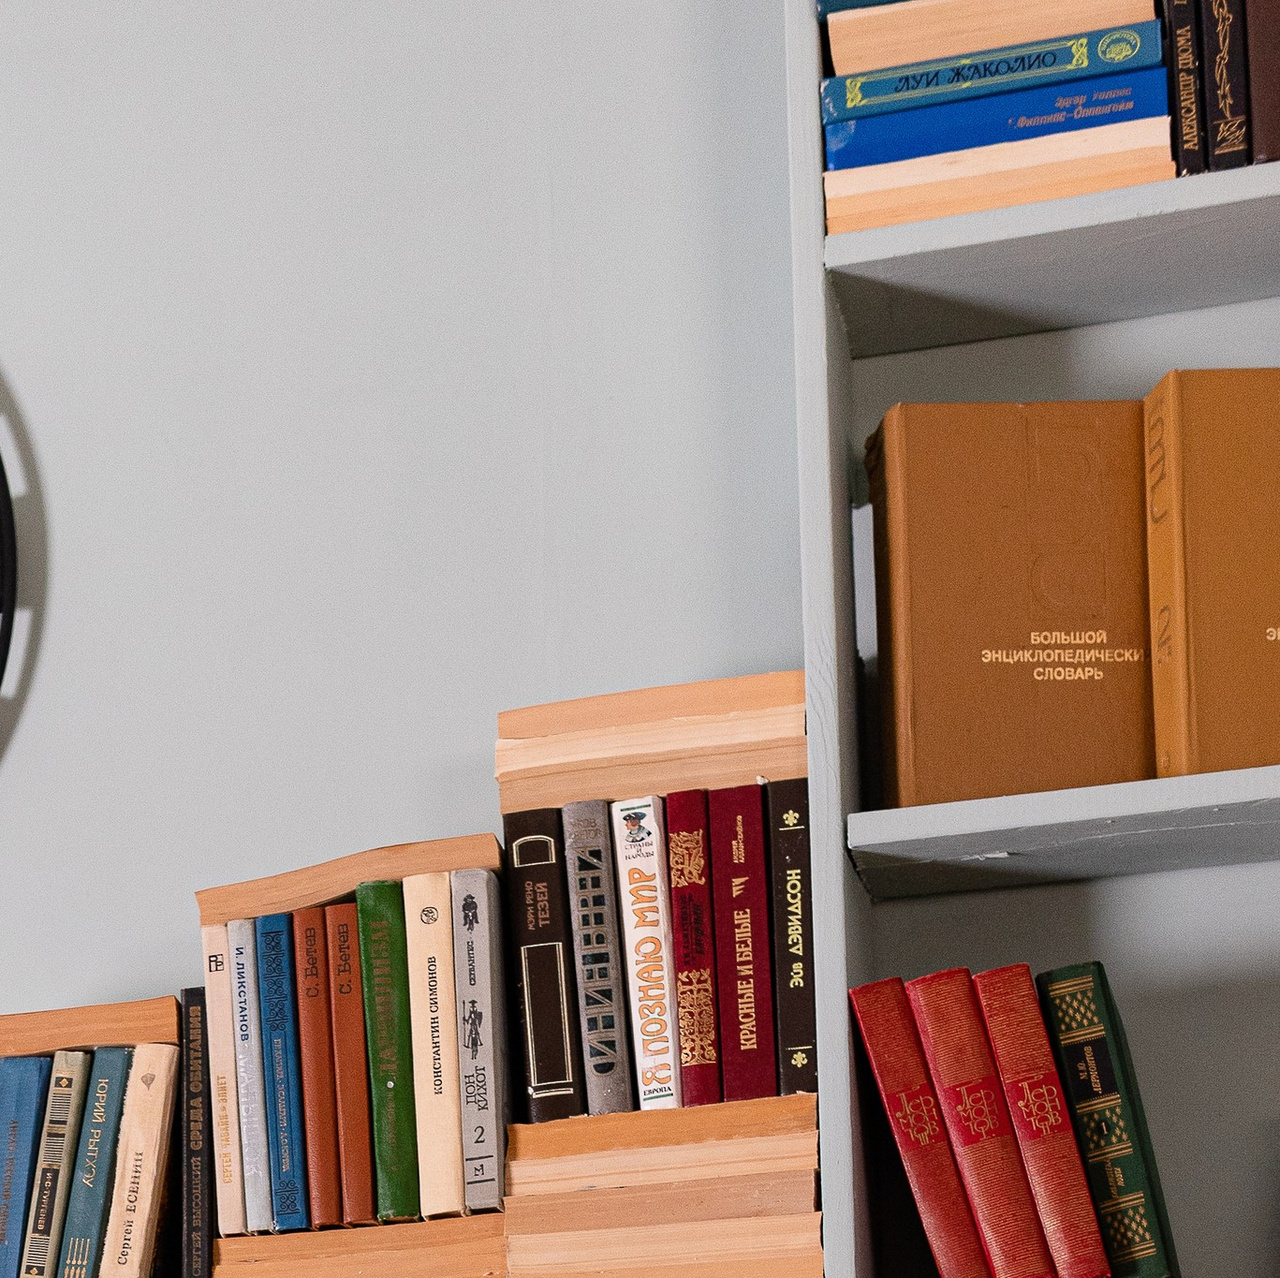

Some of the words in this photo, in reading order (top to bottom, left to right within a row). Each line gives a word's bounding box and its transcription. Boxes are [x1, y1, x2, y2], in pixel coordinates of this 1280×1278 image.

[1175, 25, 1195, 69] ДЮМА
[893, 70, 940, 93] ЛУИ
[947, 51, 1058, 84] ЖАКОЛИО
[1179, 72, 1198, 150] АЛЕКСАНДР
[1031, 629, 1107, 645] БОЛЬШОЙ
[1033, 666, 1104, 681] СЛОВАРЬ
[628, 867, 658, 929] МИР
[786, 868, 803, 956] ДЭВИДСОН
[235, 947, 245, 959] И.
[303, 927, 318, 978] Бетев
[335, 923, 351, 974] Бетев
[734, 908, 753, 962] БЕЛЫЕ
[305, 983, 320, 998] С.
[338, 979, 353, 995] С.
[426, 956, 440, 1013] СИМОНОВ
[634, 936, 669, 1056] ПОЗНАЮ
[736, 967, 751, 976] И
[235, 961, 250, 1042] ЛИКСТАНОВ
[736, 978, 757, 1051] КРАСНЫЕ
[429, 1015, 444, 1095] КОНСТАНТИН
[641, 1062, 672, 1087] Я
[1084, 1045, 1103, 1094] ЛЕРМОНТОВ
[91, 1078, 109, 1123] ЮРИЙ
[465, 1073, 477, 1106] ДОН
[474, 1066, 489, 1111] КИХОТ
[81, 1129, 102, 1188] РЫТХЭУ
[125, 1151, 144, 1213] ЕСЕНИН
[117, 1219, 135, 1265] Сергей
